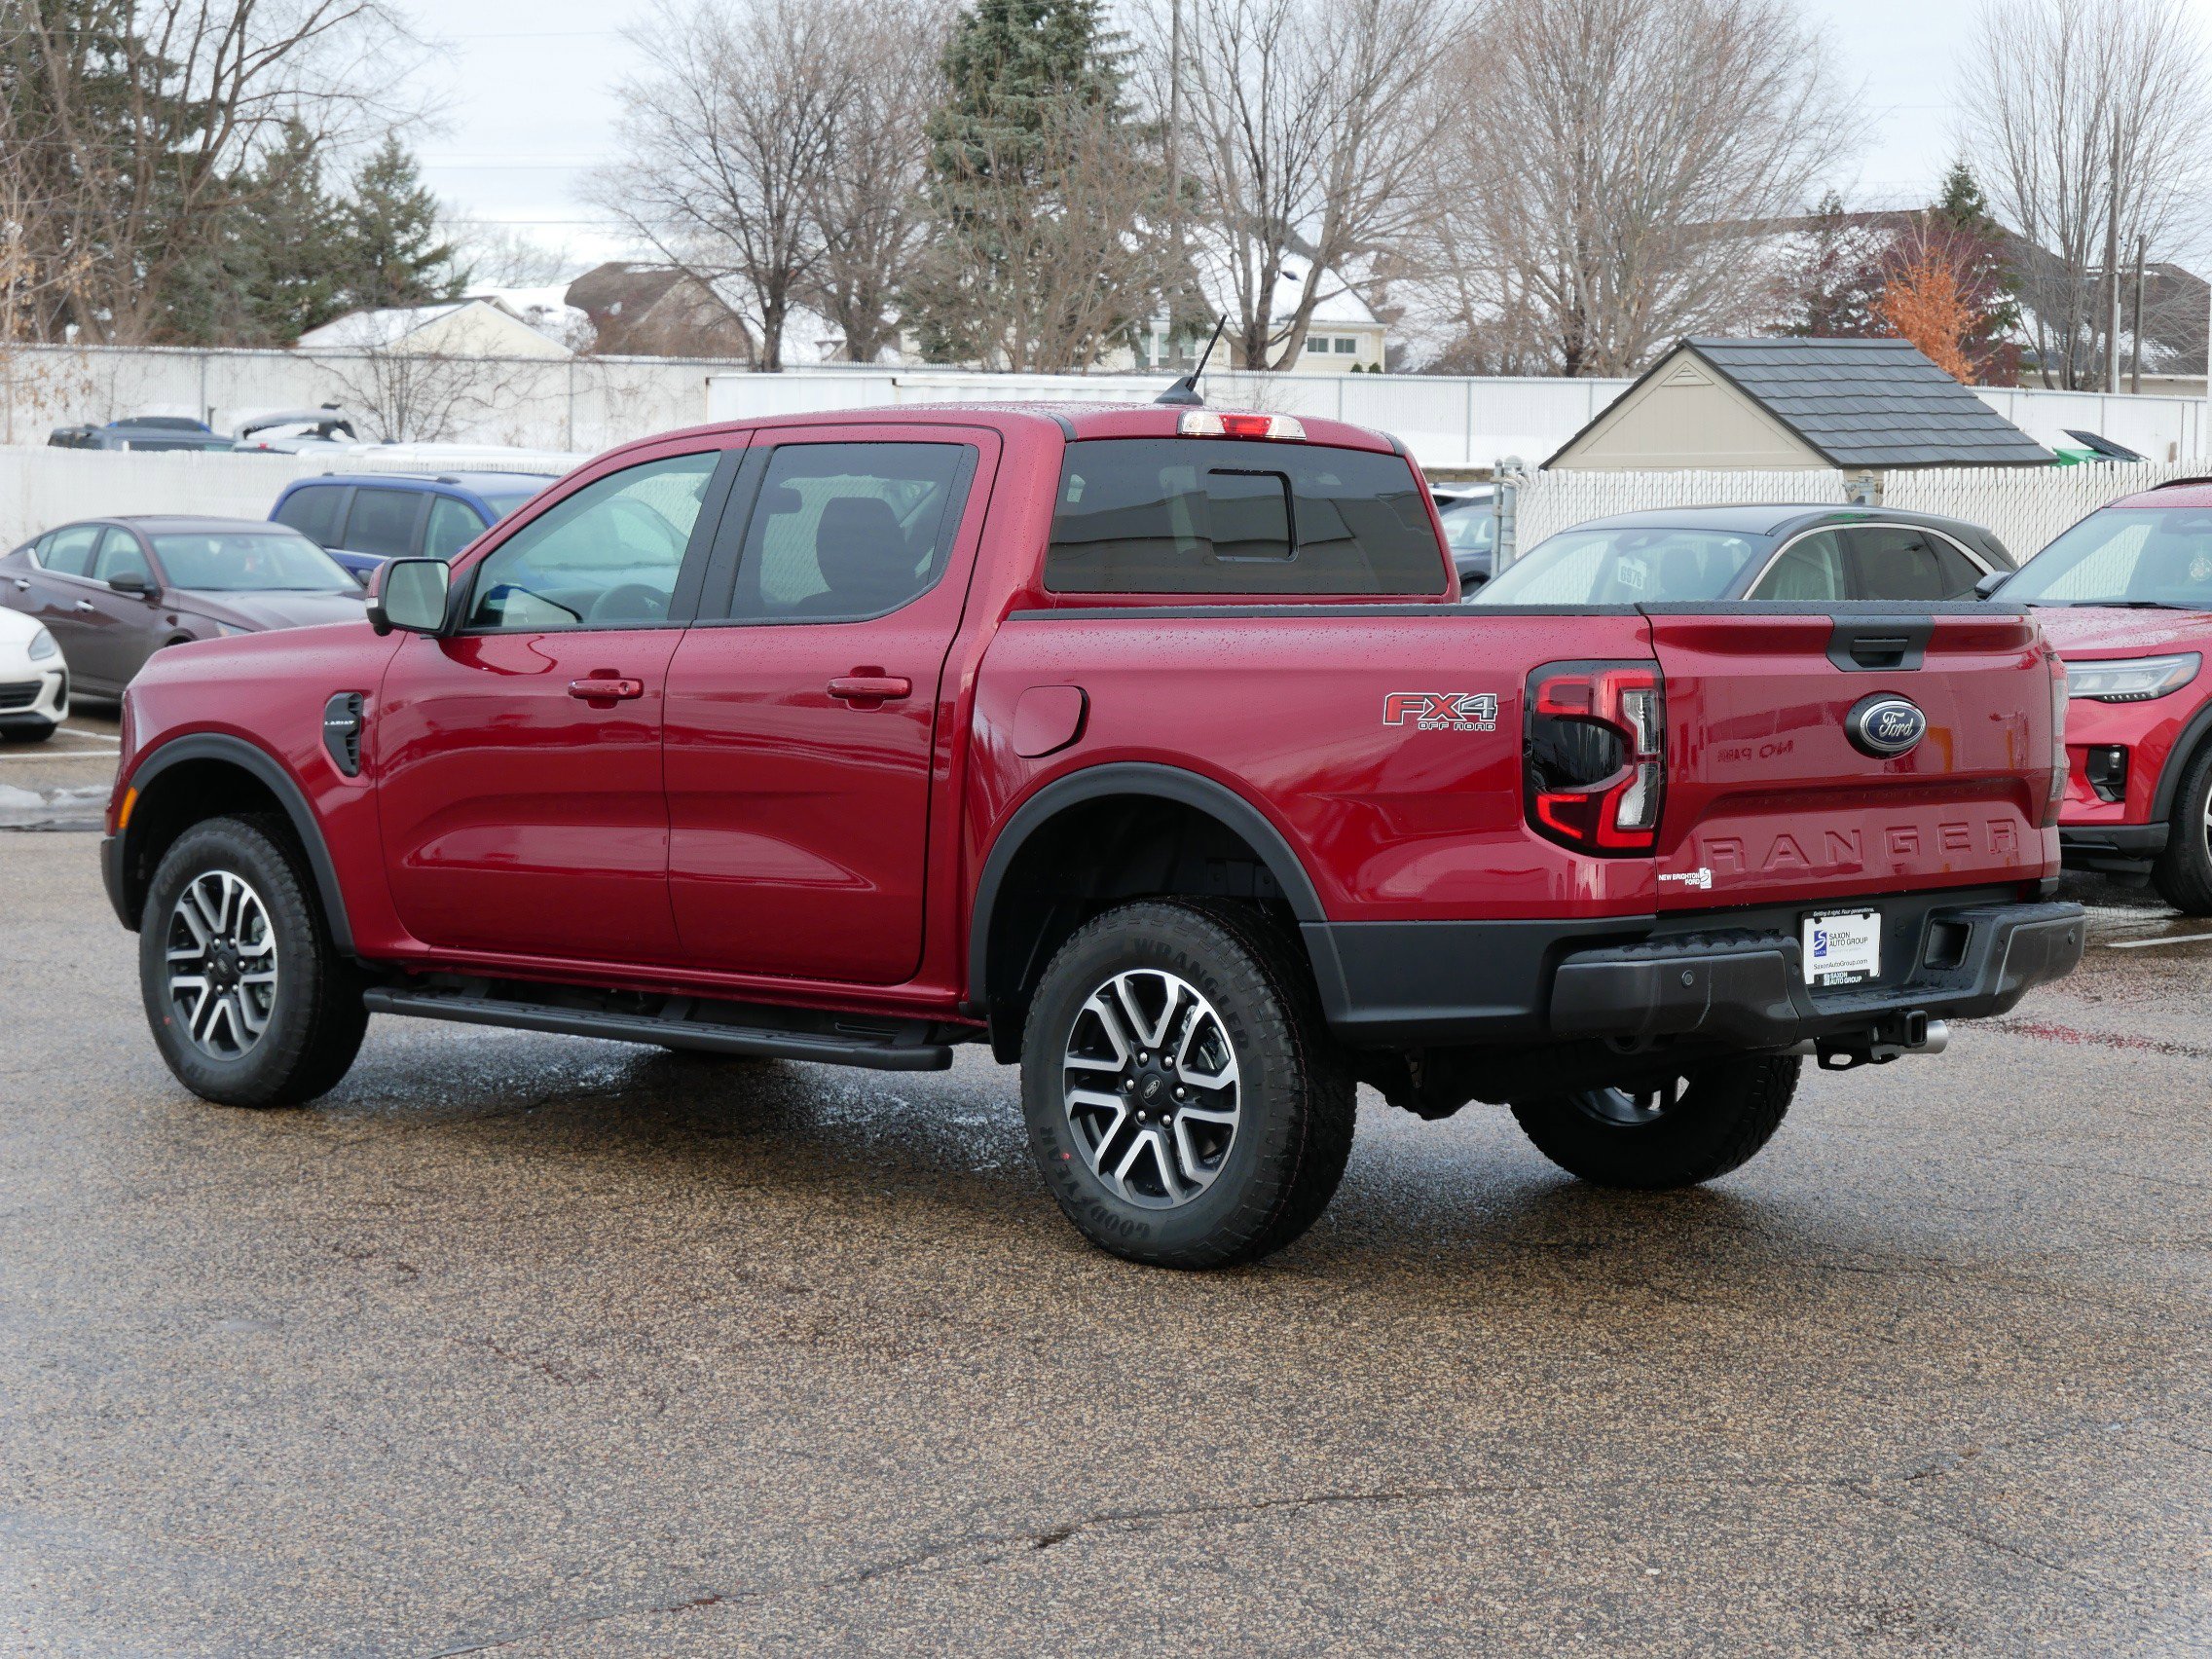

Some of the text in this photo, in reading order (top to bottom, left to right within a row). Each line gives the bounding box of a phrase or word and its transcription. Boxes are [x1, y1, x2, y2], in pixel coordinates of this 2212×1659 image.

[1383, 692, 1497, 725] FX4
[1418, 721, 1496, 732] OFF ROAD
[1878, 711, 1914, 738] Ford
[1703, 818, 2020, 873] RANGER
[1846, 937, 1868, 945] GROUP
[1814, 959, 1868, 970] SaxonAutoGroup.com
[1133, 937, 1250, 1051] WRANGLER
